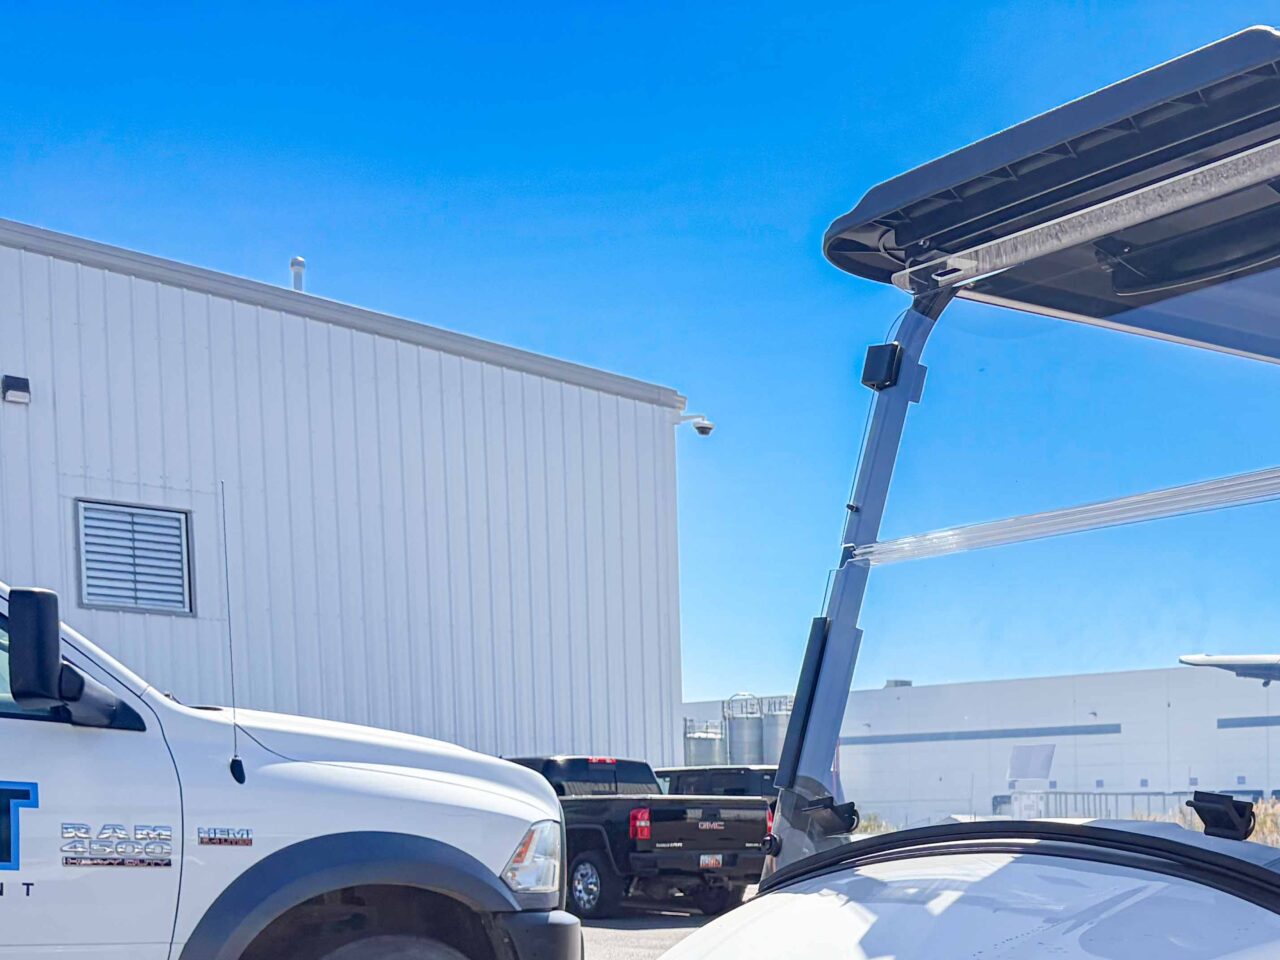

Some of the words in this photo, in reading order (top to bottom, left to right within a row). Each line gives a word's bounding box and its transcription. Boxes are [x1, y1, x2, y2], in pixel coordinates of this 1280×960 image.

[61, 822, 172, 841] RAM
[197, 827, 253, 839] HEMI
[698, 821, 725, 830] GMC
[60, 839, 172, 858] 4500
